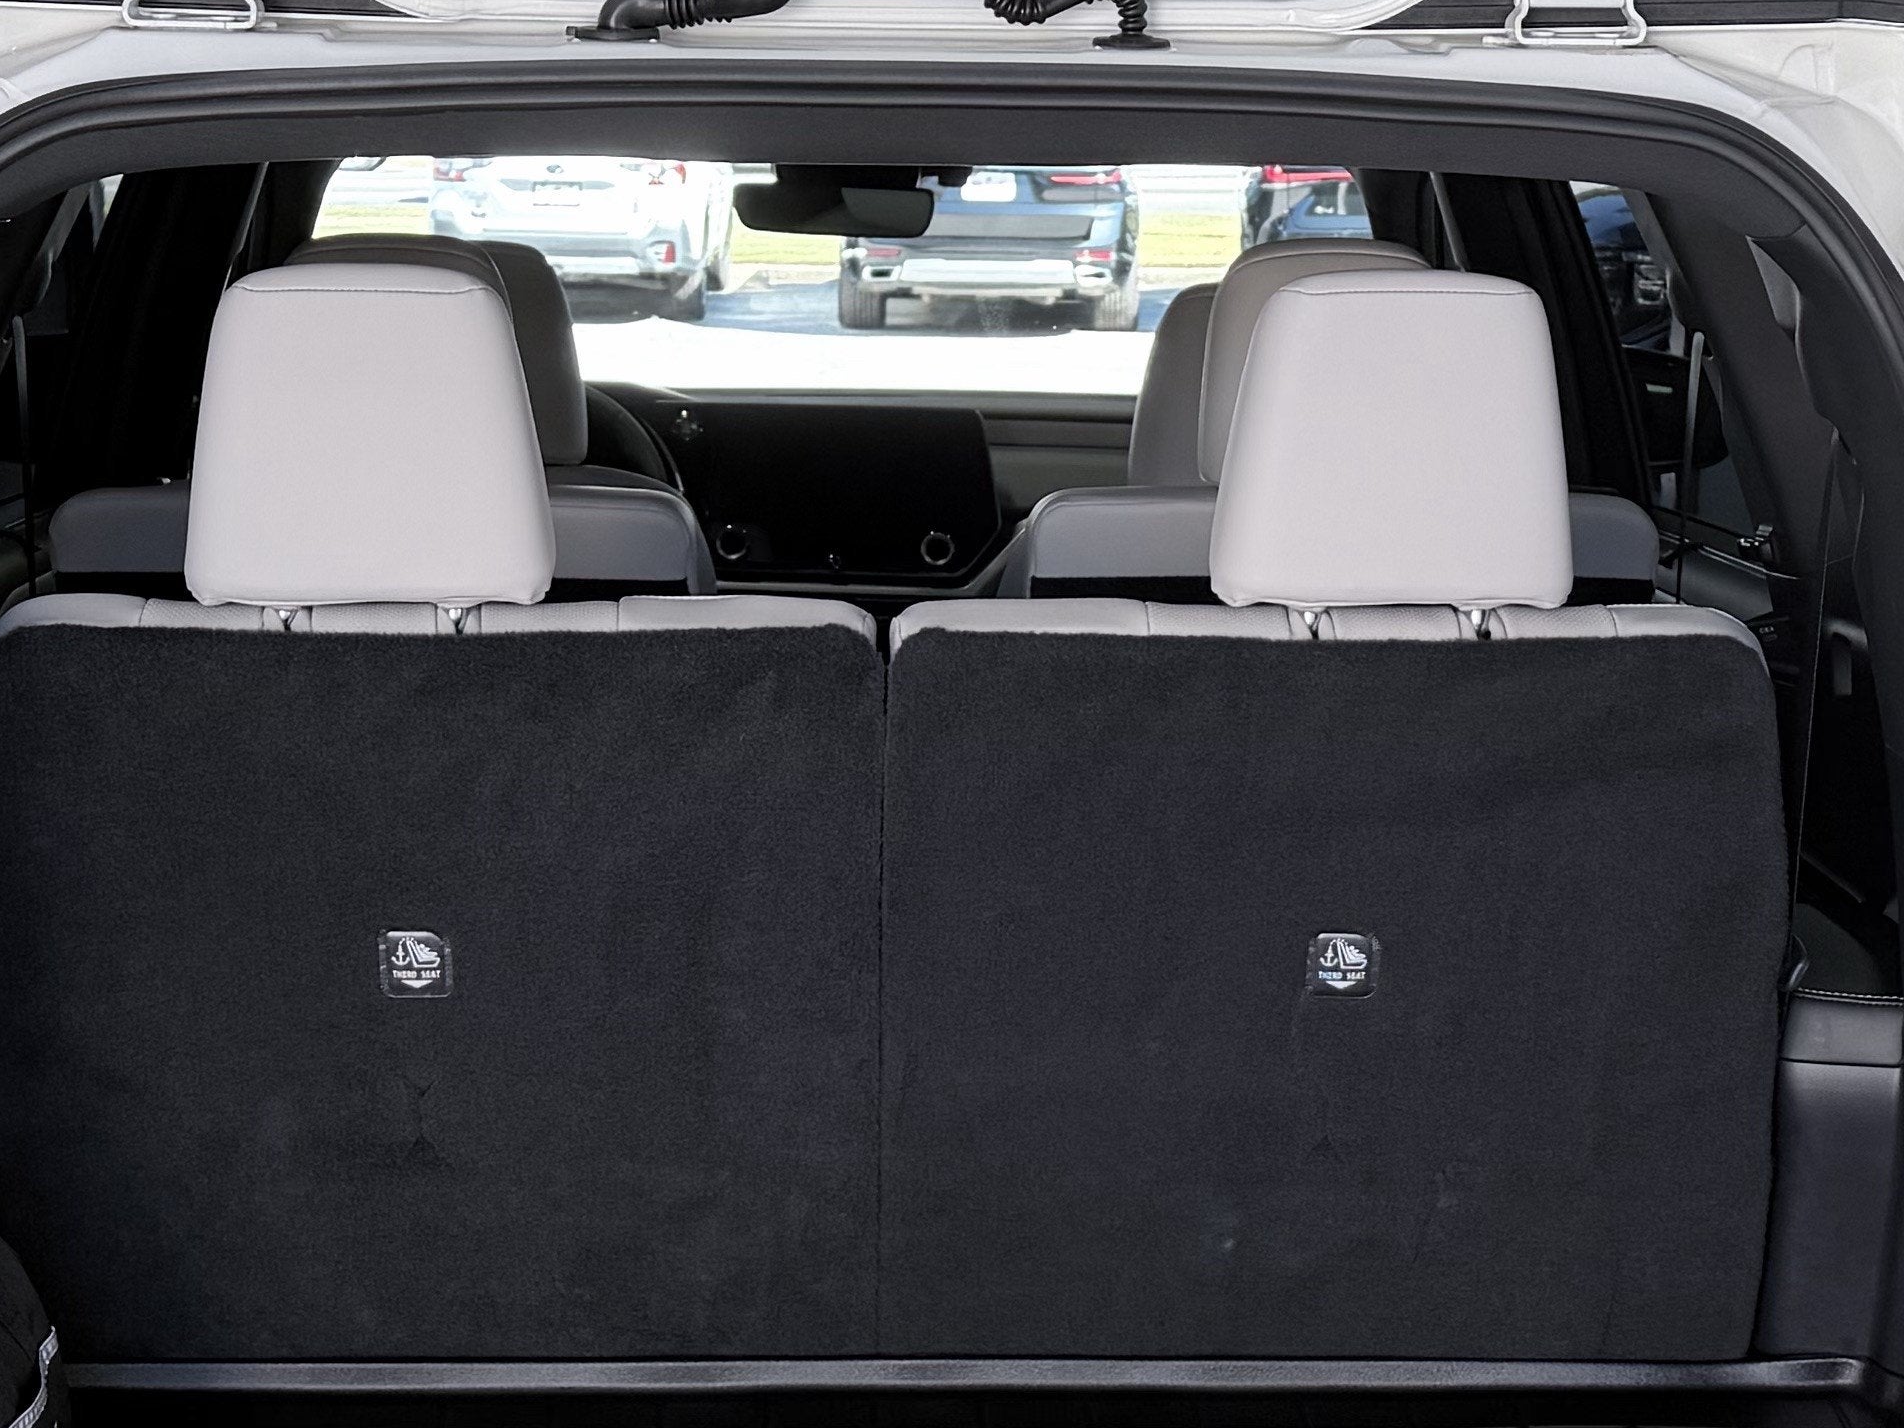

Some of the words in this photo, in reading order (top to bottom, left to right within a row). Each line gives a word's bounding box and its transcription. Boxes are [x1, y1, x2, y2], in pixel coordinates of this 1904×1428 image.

[392, 969, 418, 979] THIRD
[420, 969, 441, 979] SEAT
[1346, 971, 1366, 980] SEAT
